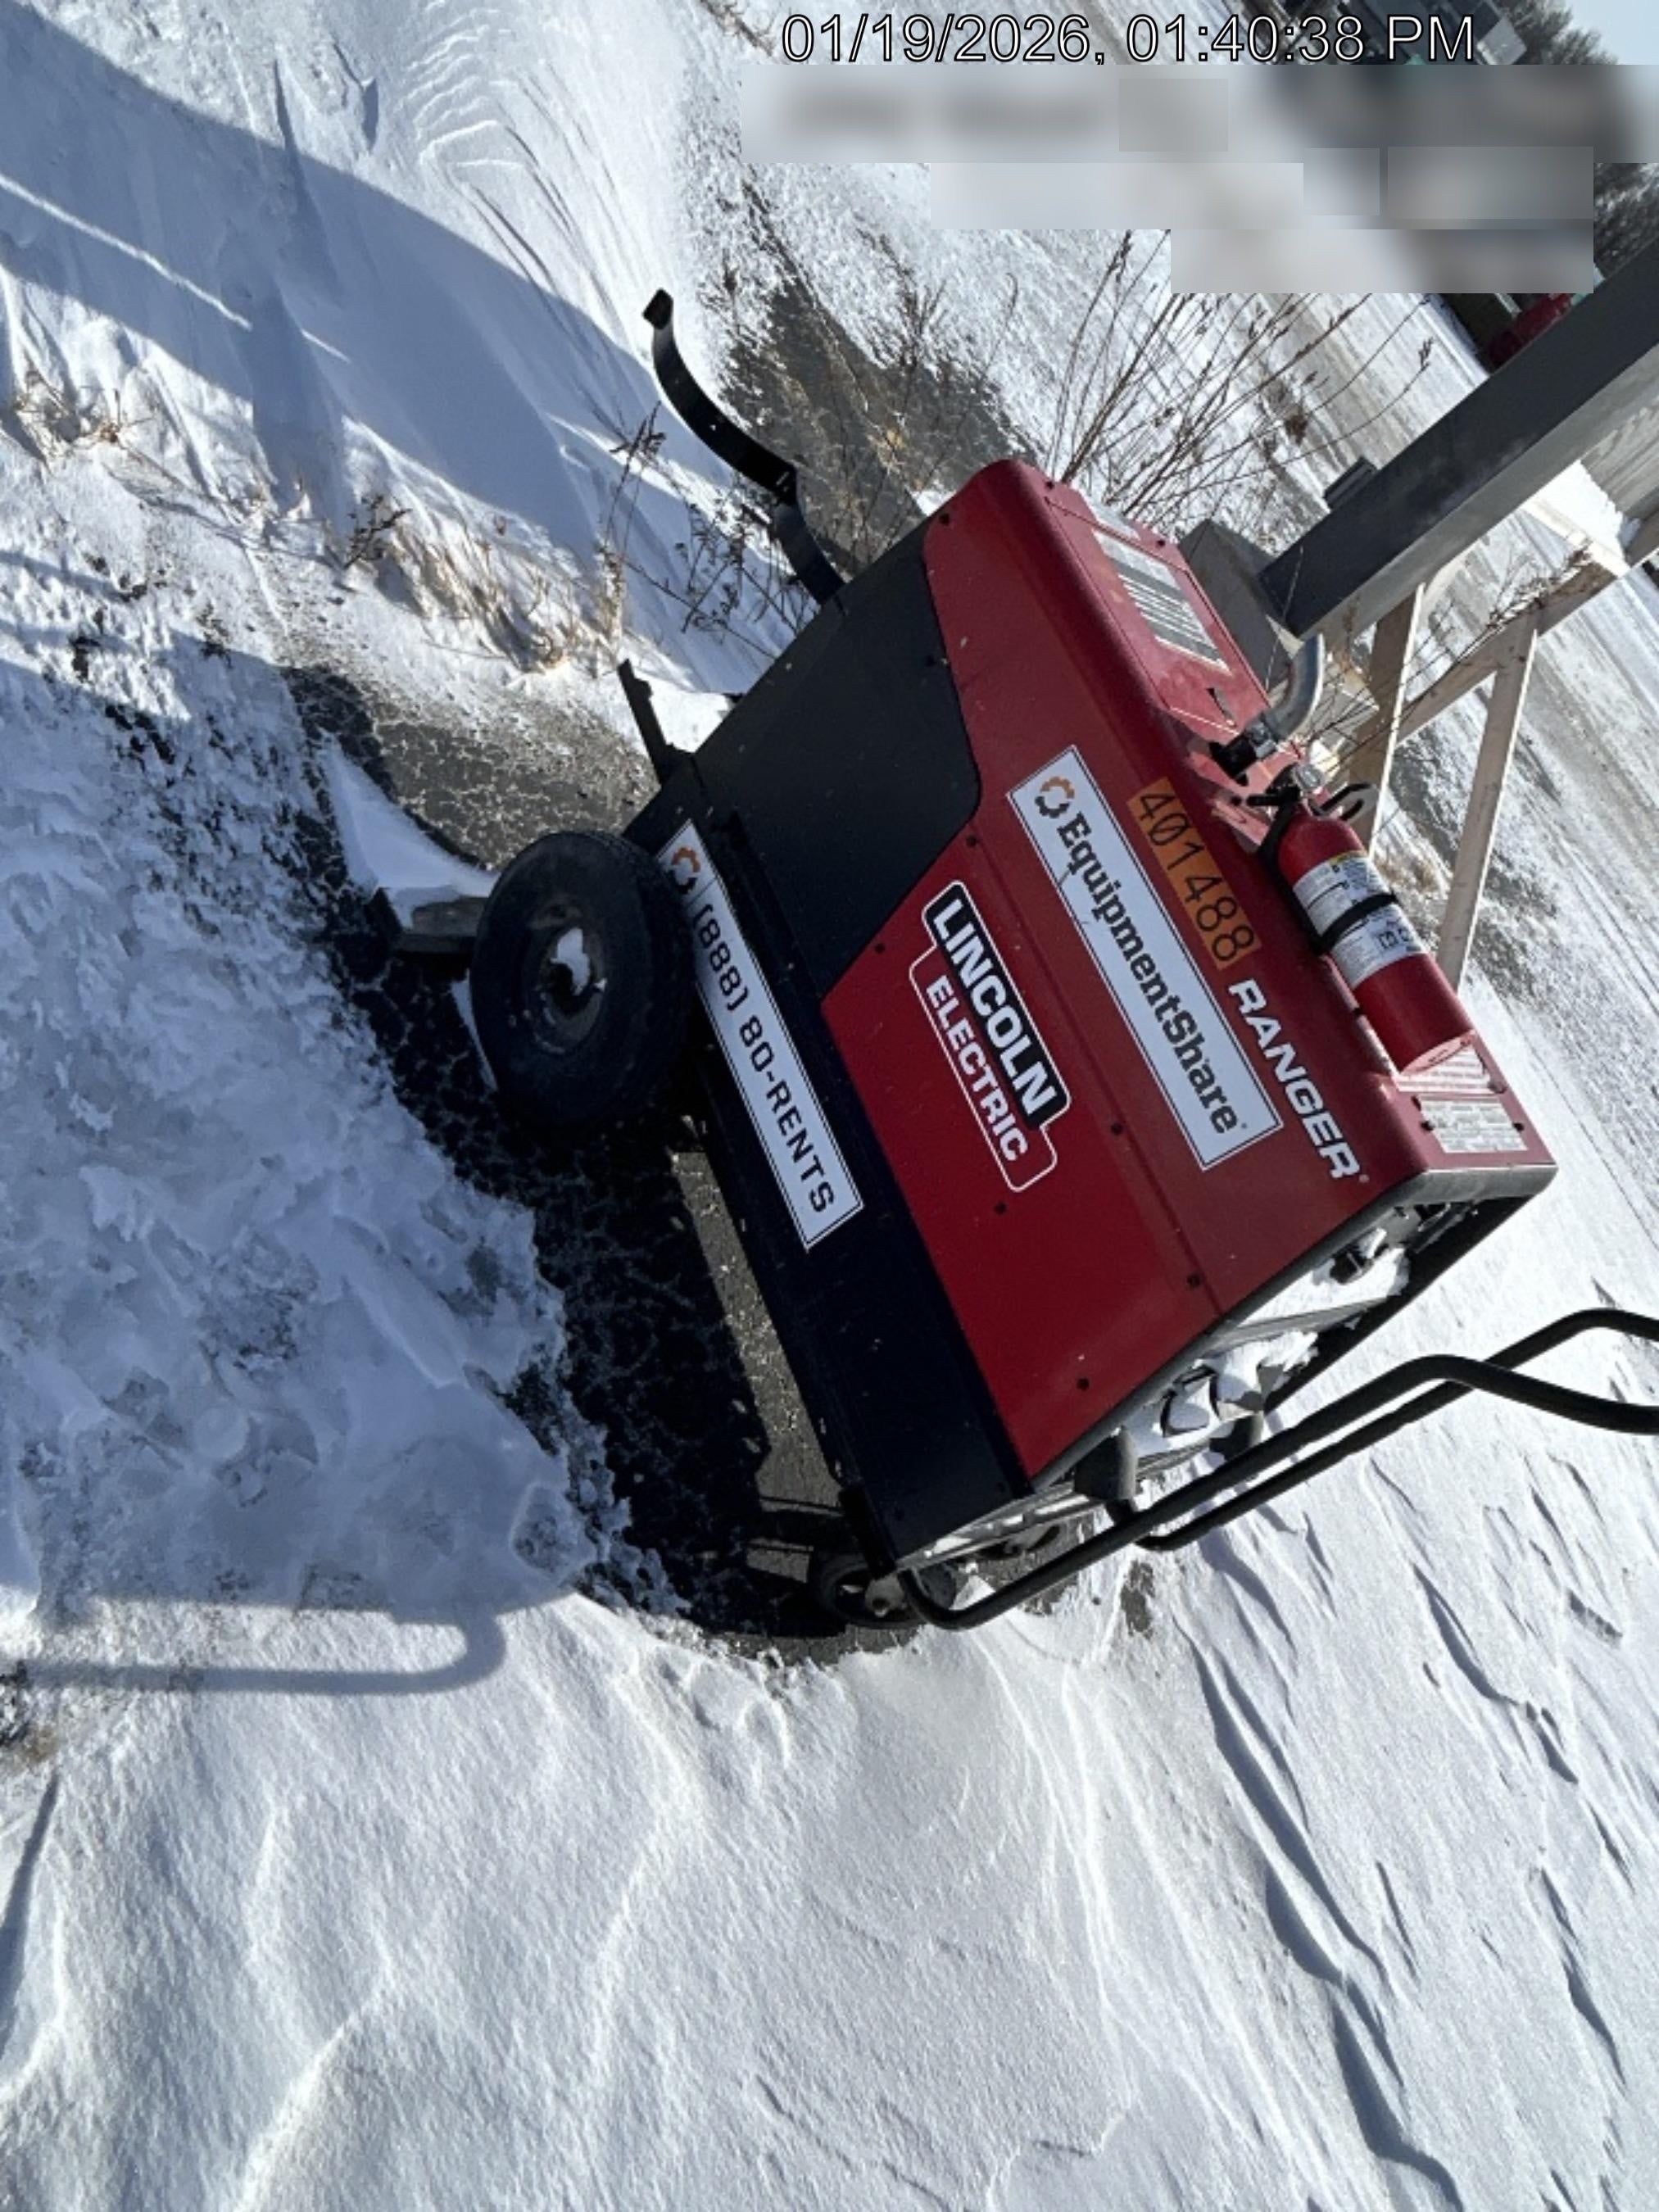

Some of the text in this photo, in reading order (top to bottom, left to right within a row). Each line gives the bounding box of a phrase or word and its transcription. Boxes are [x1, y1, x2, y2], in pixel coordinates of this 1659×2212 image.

[1057, 811, 1239, 1135] EquipmentShare
[1139, 792, 1255, 962] 401488
[926, 974, 1029, 1162] ELECTRIC
[934, 899, 1058, 1117] LINCOLN
[1228, 979, 1361, 1179] RANGER
[739, 1015, 835, 1213] 80-RENTS
